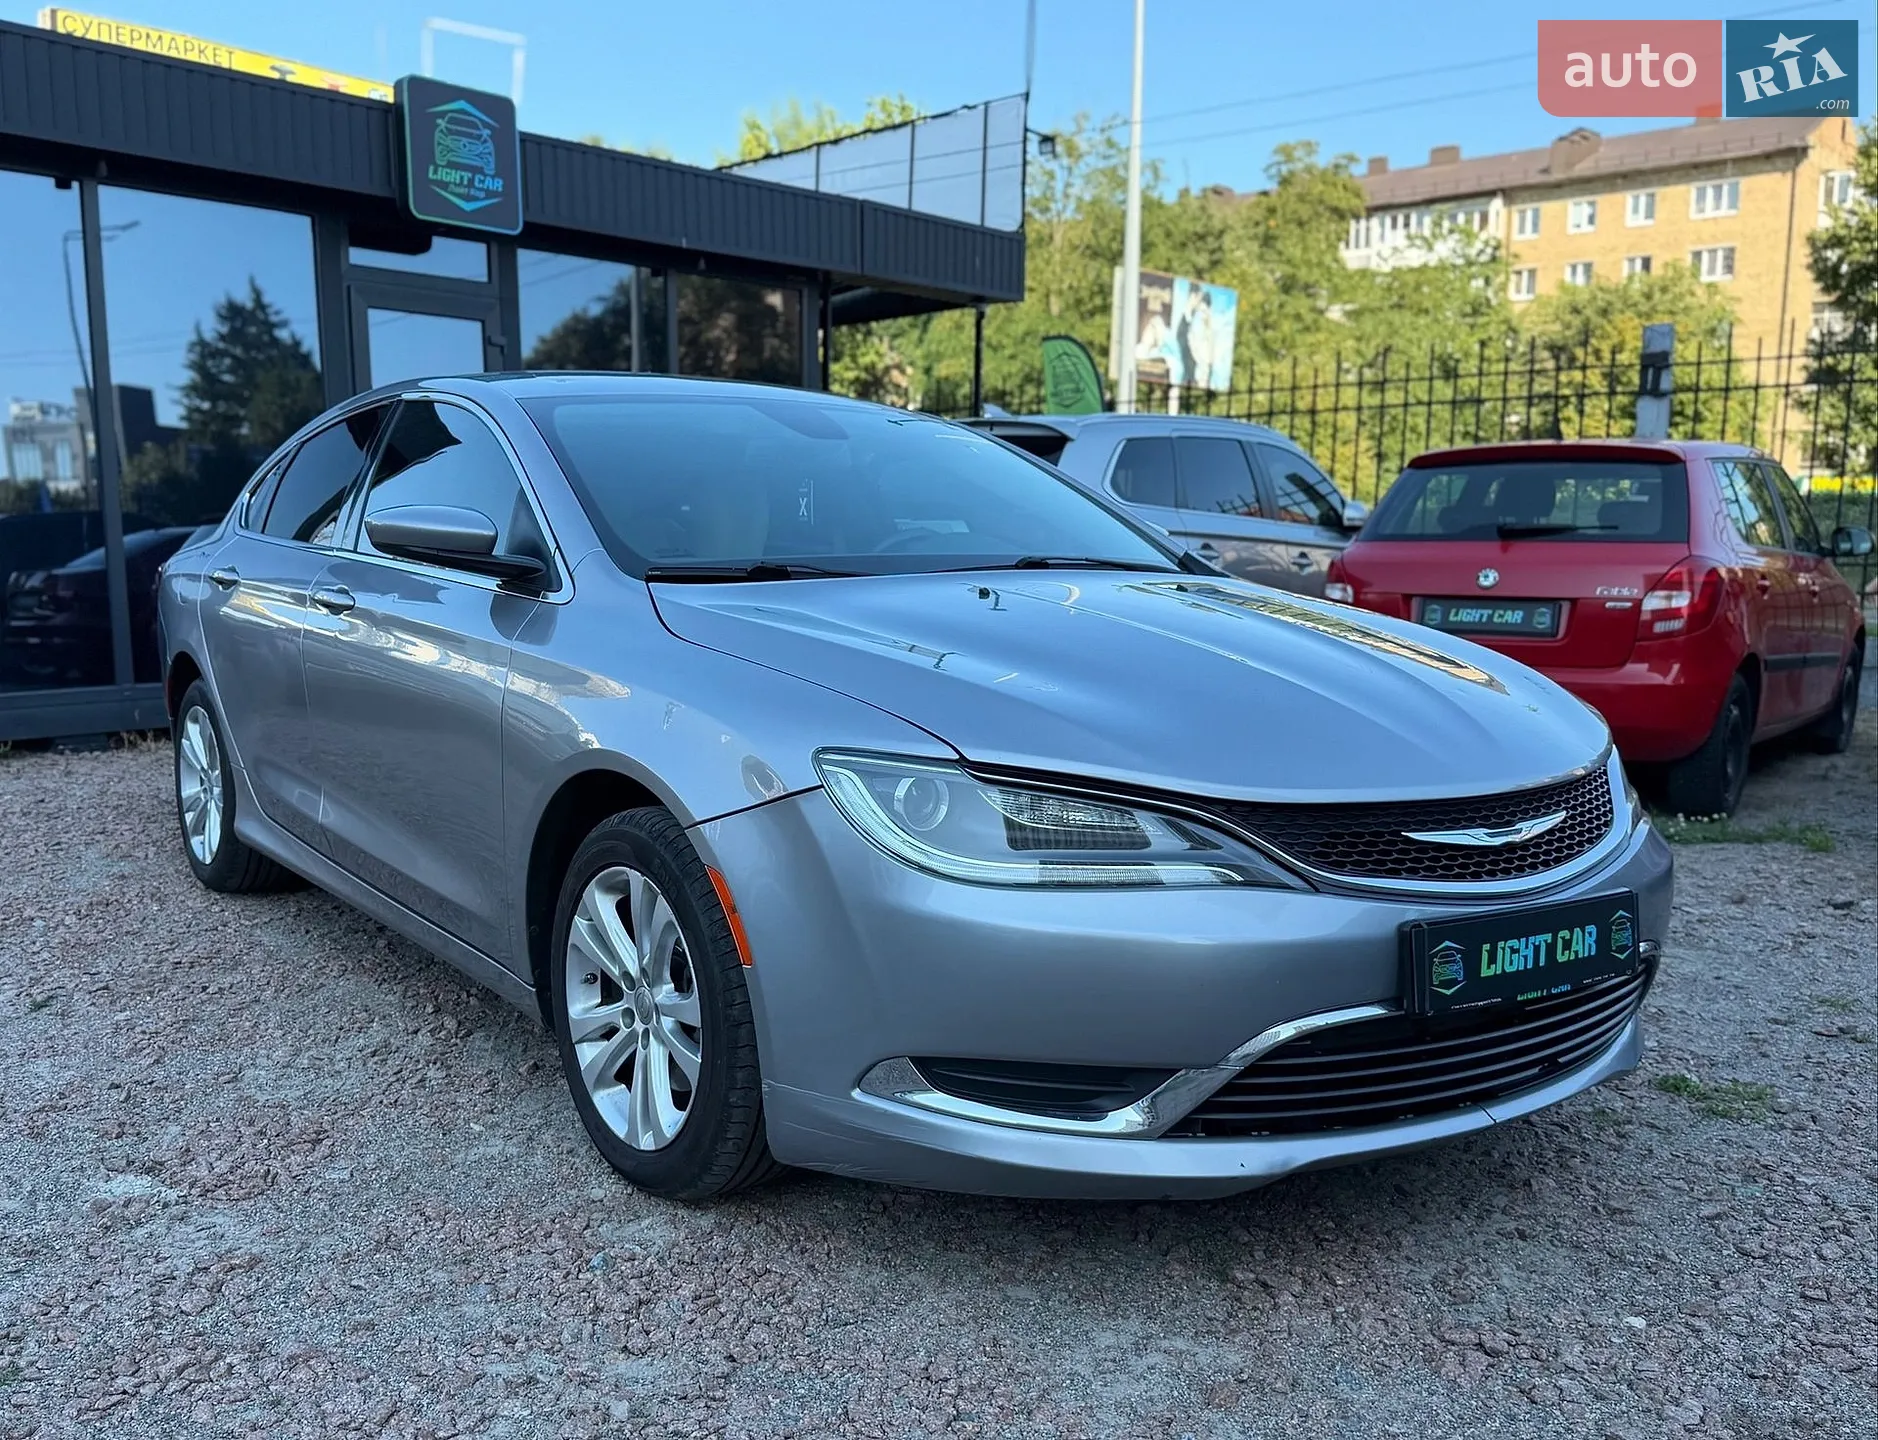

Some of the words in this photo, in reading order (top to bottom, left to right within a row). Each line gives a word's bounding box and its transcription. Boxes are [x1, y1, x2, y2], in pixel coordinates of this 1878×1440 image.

[62, 14, 236, 70] СУПЕРМАРКЕТ
[428, 164, 473, 186] LIGHT
[473, 173, 505, 193] CAR
[1448, 607, 1493, 623] LIGHT
[1492, 608, 1524, 624] CAR
[1480, 933, 1552, 977] LIGHT
[1556, 924, 1597, 963] CAR
